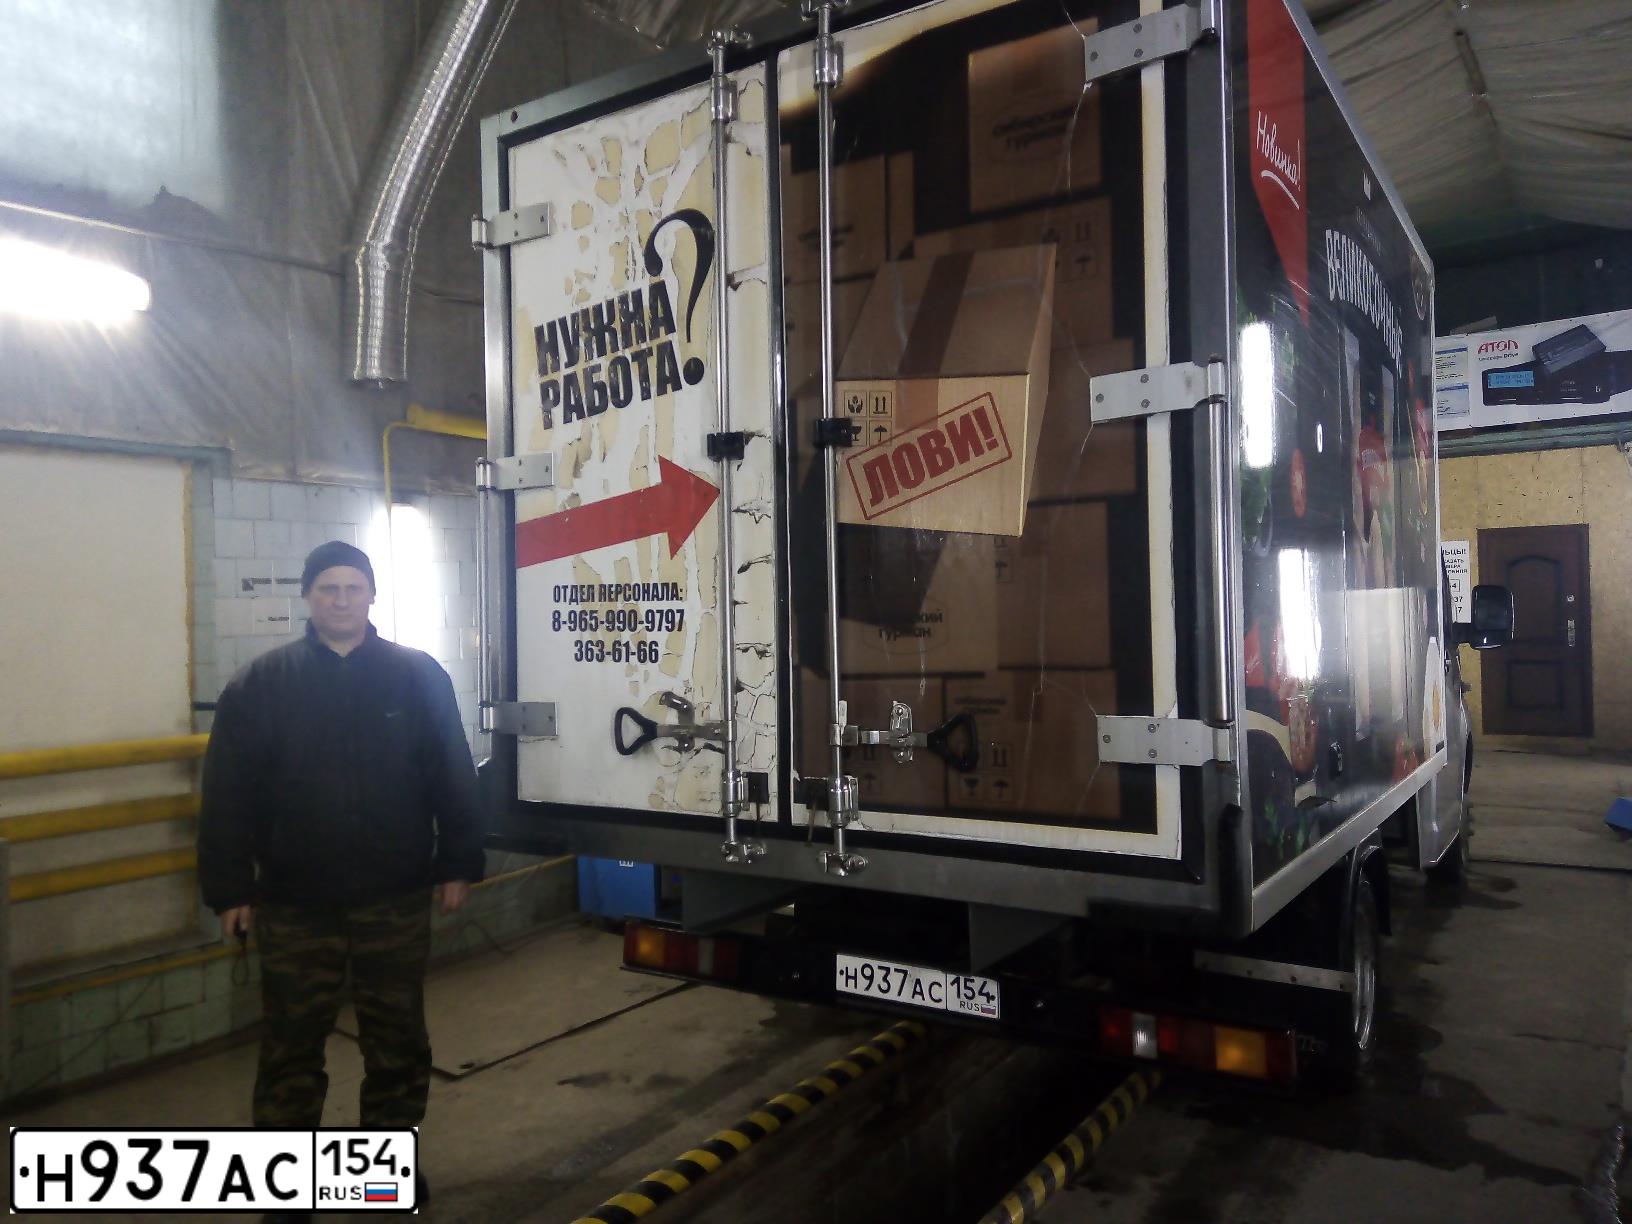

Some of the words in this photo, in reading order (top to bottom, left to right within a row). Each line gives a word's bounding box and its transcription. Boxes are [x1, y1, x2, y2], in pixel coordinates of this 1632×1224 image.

[1256, 110, 1301, 192] Новинка!
[534, 279, 676, 377] НУЖНА
[863, 405, 999, 507] ЛОВИ!
[553, 584, 595, 605] ОТДЕЛ
[598, 582, 683, 602] ПЕРСОНАЛА:
[552, 608, 685, 632] 8-965-990-9797
[574, 639, 659, 663] 363-61-66
[950, 976, 991, 1003] 154
[959, 1000, 980, 1012] RUS
